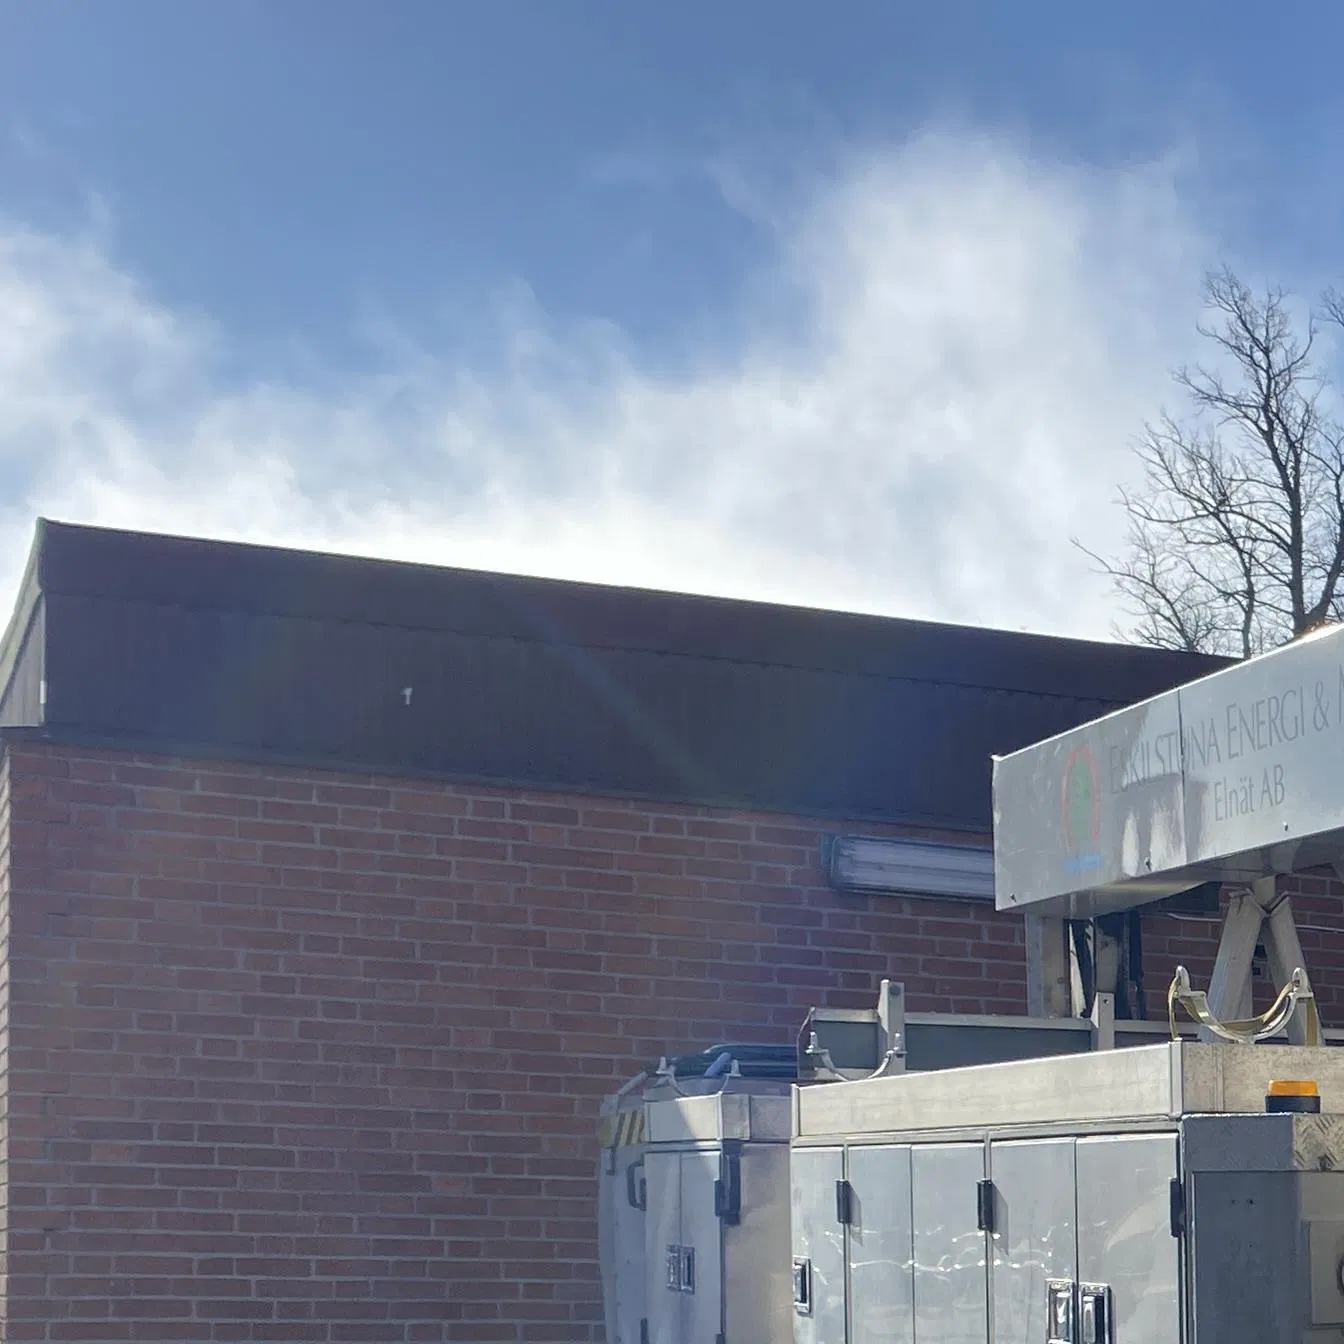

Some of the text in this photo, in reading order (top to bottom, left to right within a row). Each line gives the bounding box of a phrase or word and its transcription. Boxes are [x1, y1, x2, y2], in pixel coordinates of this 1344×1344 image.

[1226, 690, 1305, 760] ENERGI
[1313, 681, 1330, 732] &
[1214, 764, 1285, 822] Elnät AB
